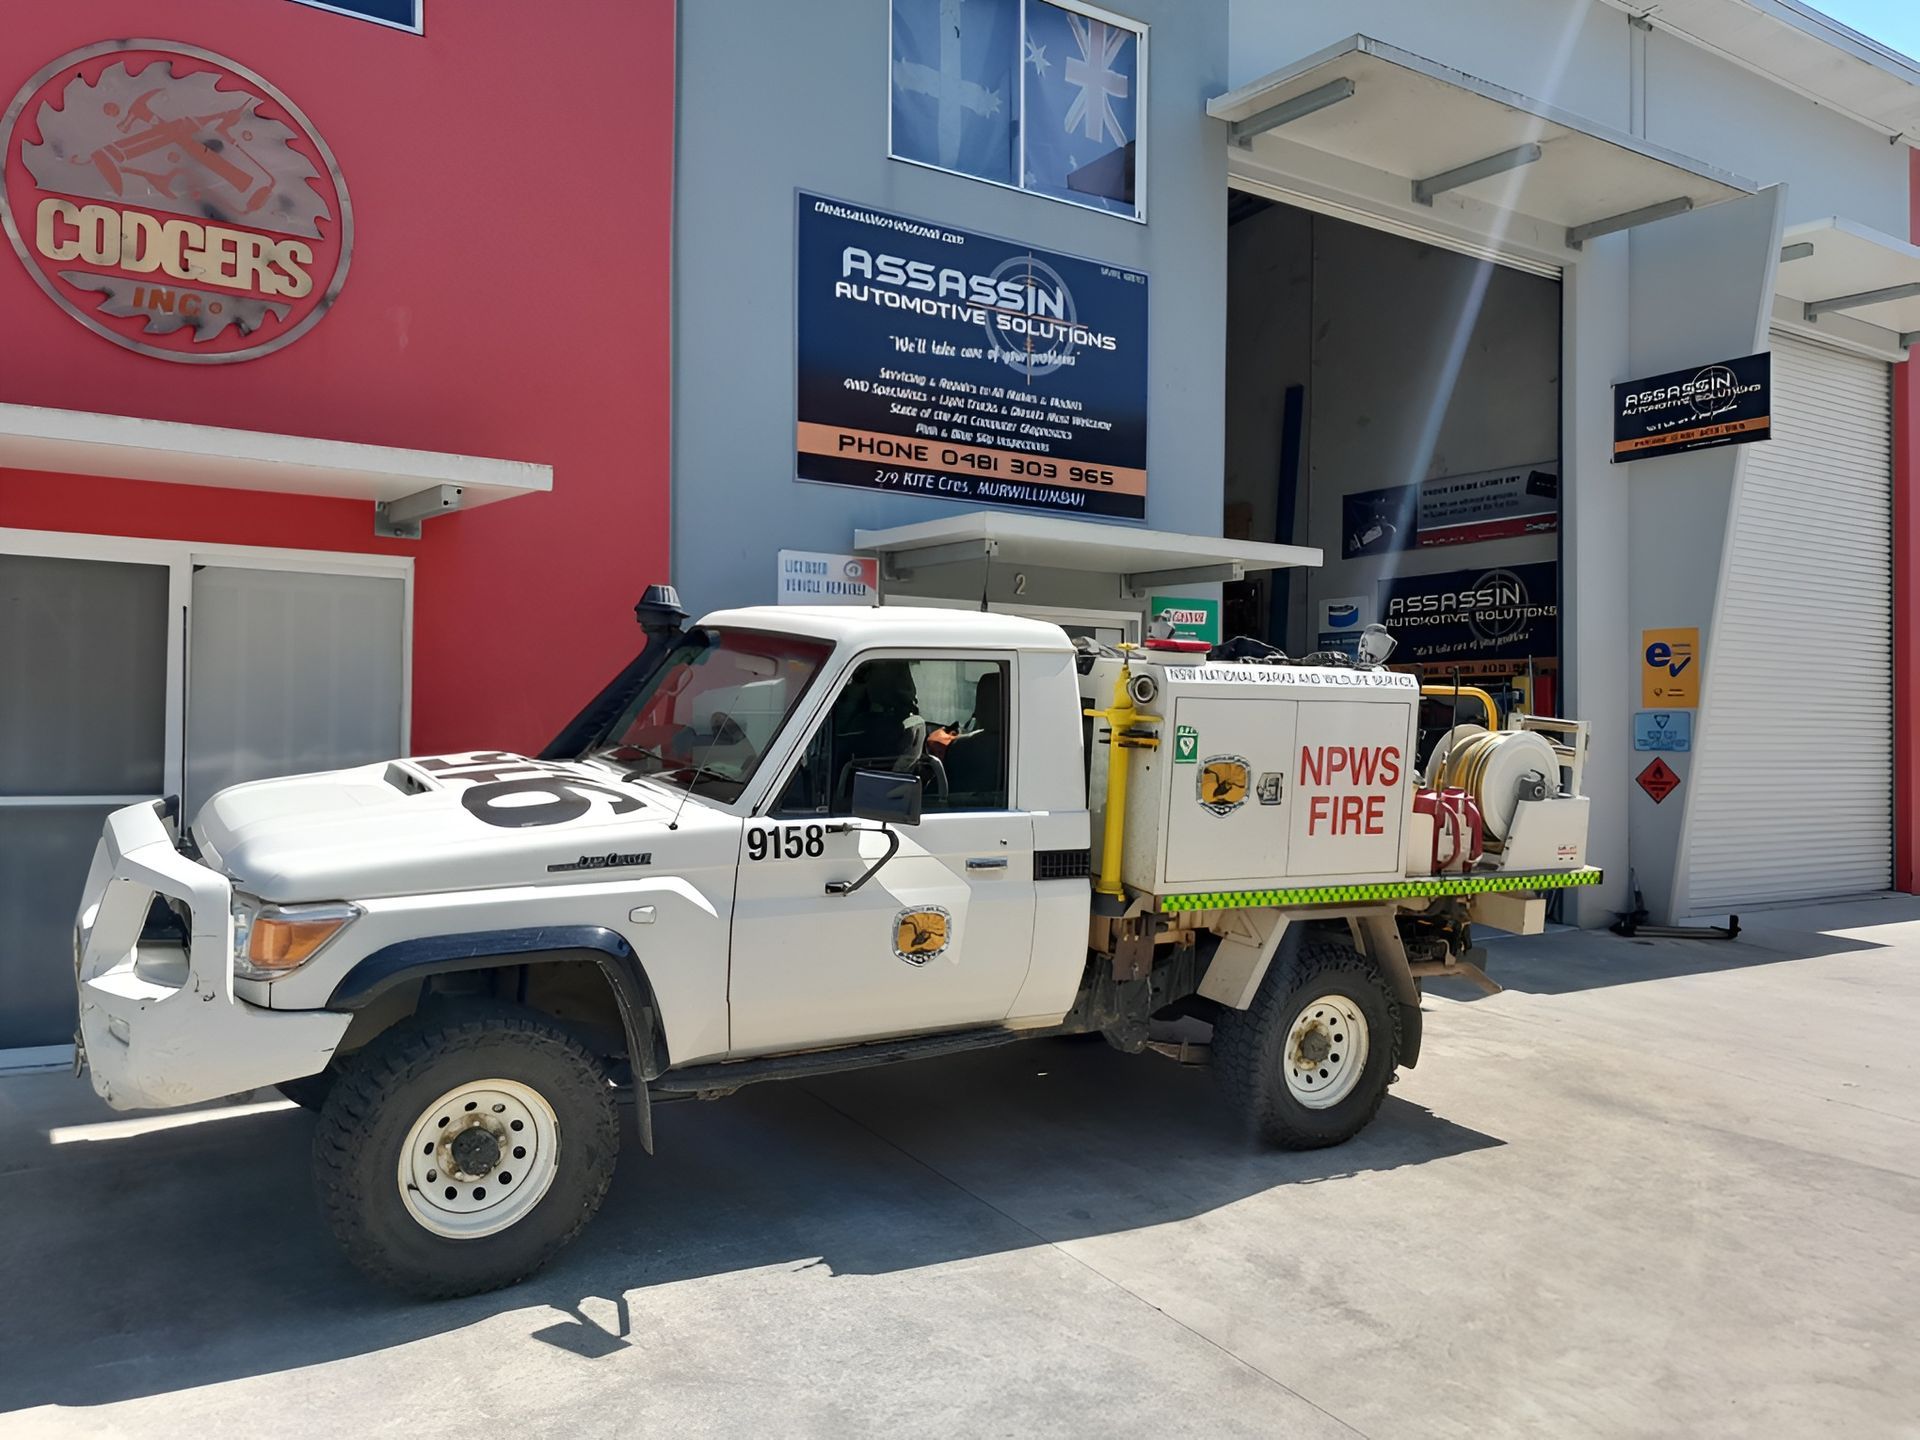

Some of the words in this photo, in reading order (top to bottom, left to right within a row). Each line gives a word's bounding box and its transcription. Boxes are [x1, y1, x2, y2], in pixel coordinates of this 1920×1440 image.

[36, 198, 313, 298] CODGERS
[842, 246, 1064, 320] ASSASSIN
[835, 281, 986, 325] AUTOMOTIVE
[996, 314, 1117, 350] SOLUTIONS
[1625, 372, 1731, 408] ASSASSIN
[838, 433, 929, 462] PHONE
[941, 448, 999, 472] 0481
[1010, 458, 1057, 479] 303
[1069, 466, 1114, 485] 965
[874, 469, 899, 485] 2/9
[902, 471, 934, 488] KITE
[1014, 573, 1026, 595] 2
[1388, 582, 1520, 616] ASSASSIN
[1300, 745, 1400, 787] NPWS
[1308, 795, 1386, 836] FIRE
[747, 824, 825, 861] 9158
